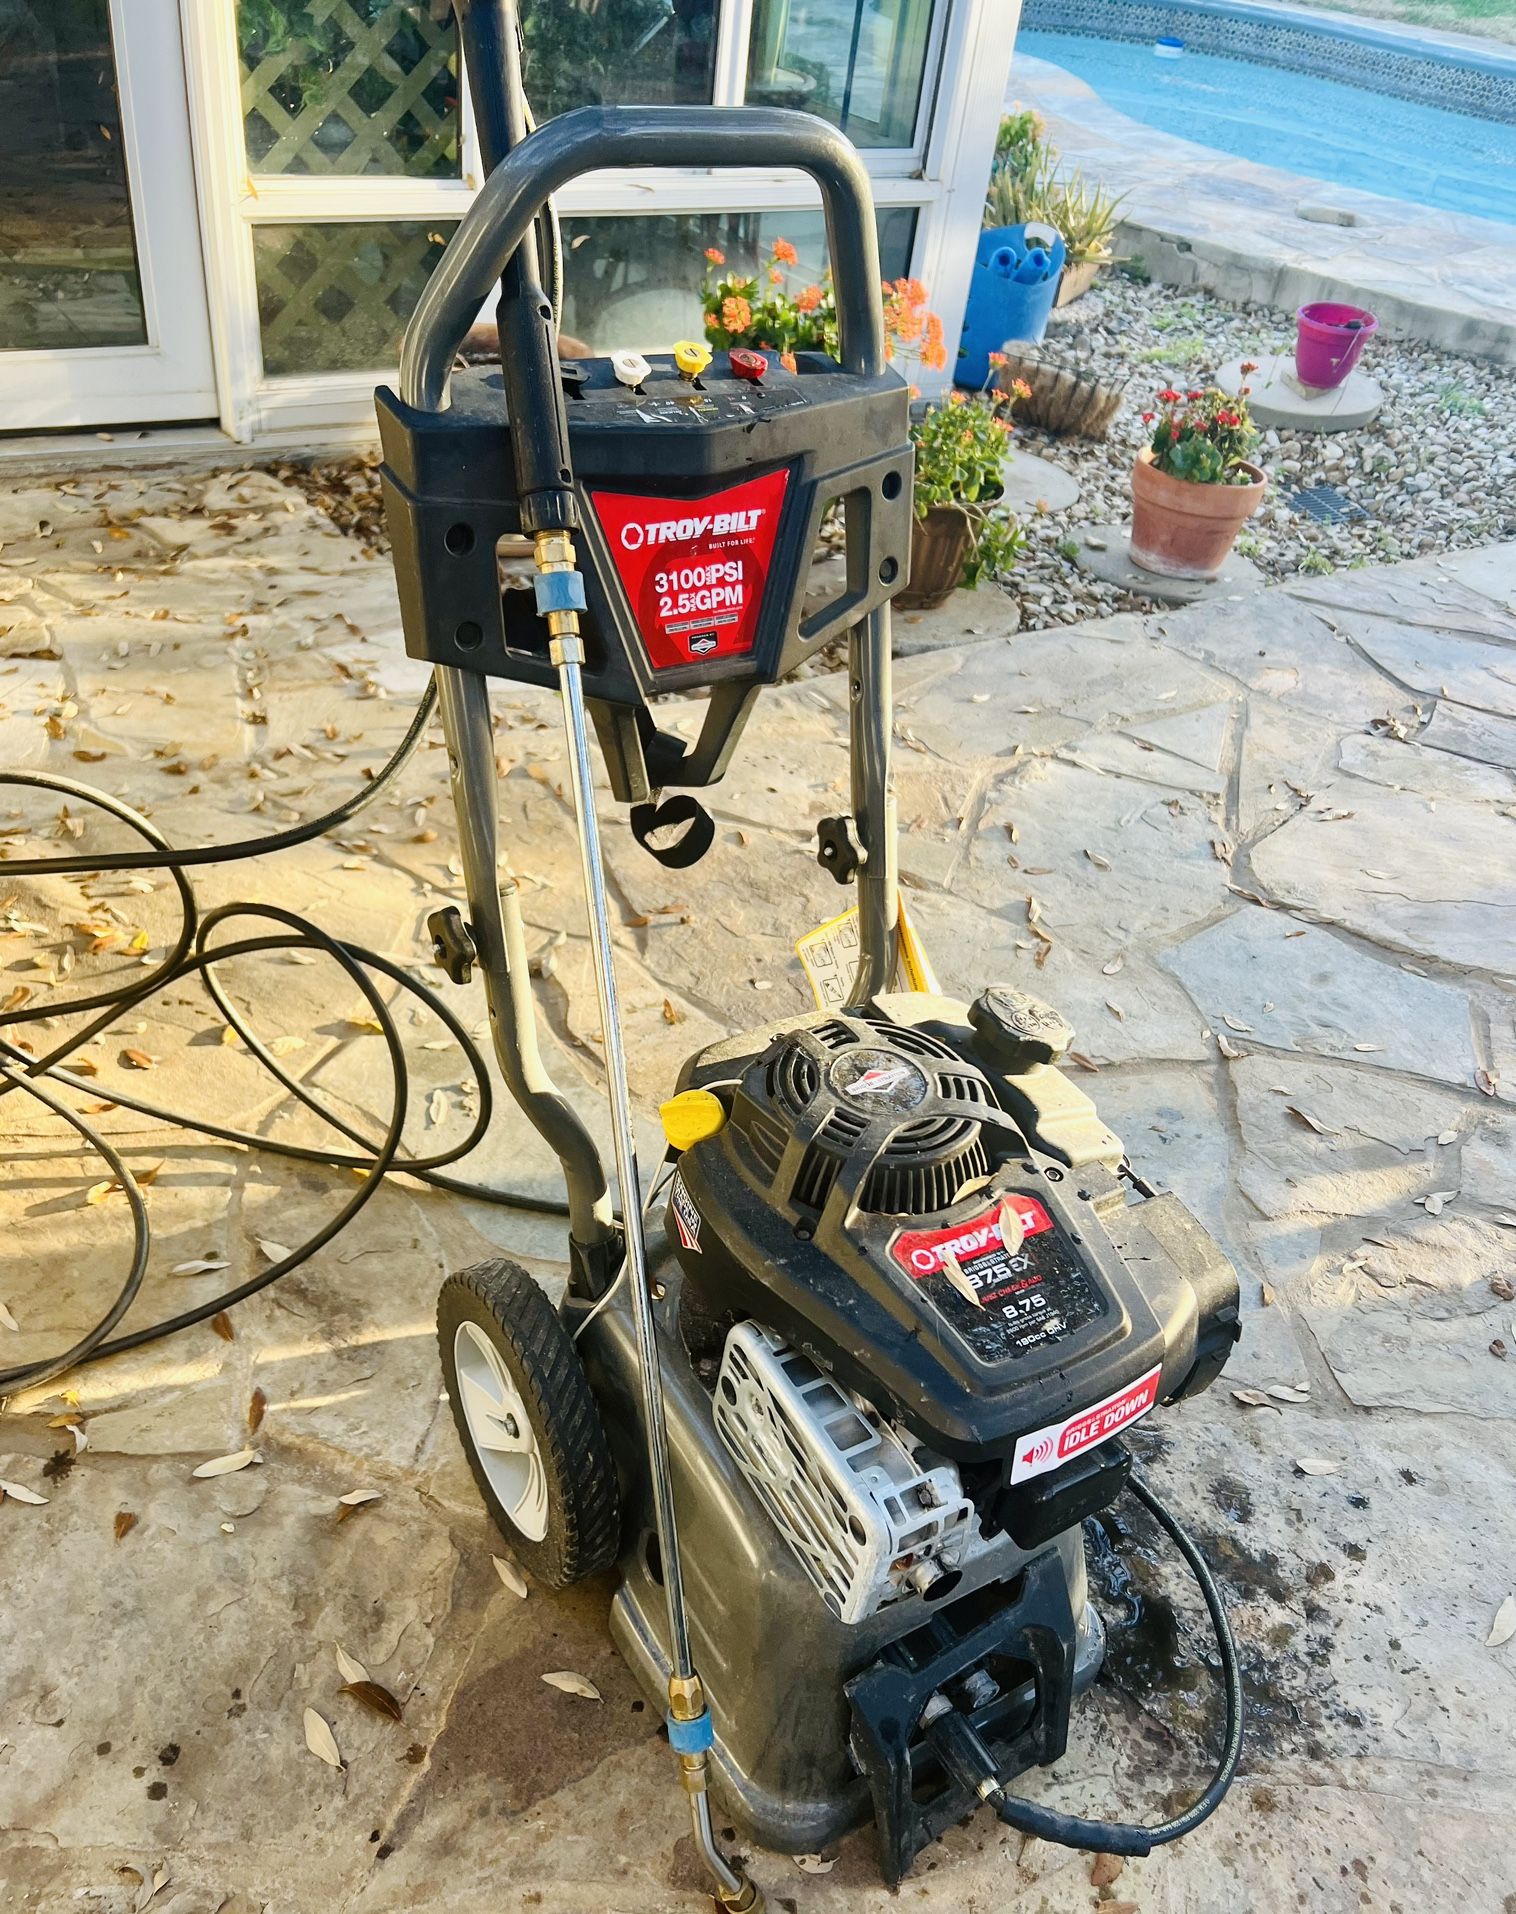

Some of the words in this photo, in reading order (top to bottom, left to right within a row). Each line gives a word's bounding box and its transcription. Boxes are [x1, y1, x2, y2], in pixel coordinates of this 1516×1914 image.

[645, 509, 763, 545] TROY-BILT
[708, 541, 726, 550] BUILT
[655, 567, 706, 594] 3100
[711, 561, 743, 585] PSI
[659, 593, 691, 617] 2.5
[695, 584, 743, 611] GPM
[1064, 1419, 1100, 1451] IDLE
[1104, 1389, 1149, 1429] DOWN
